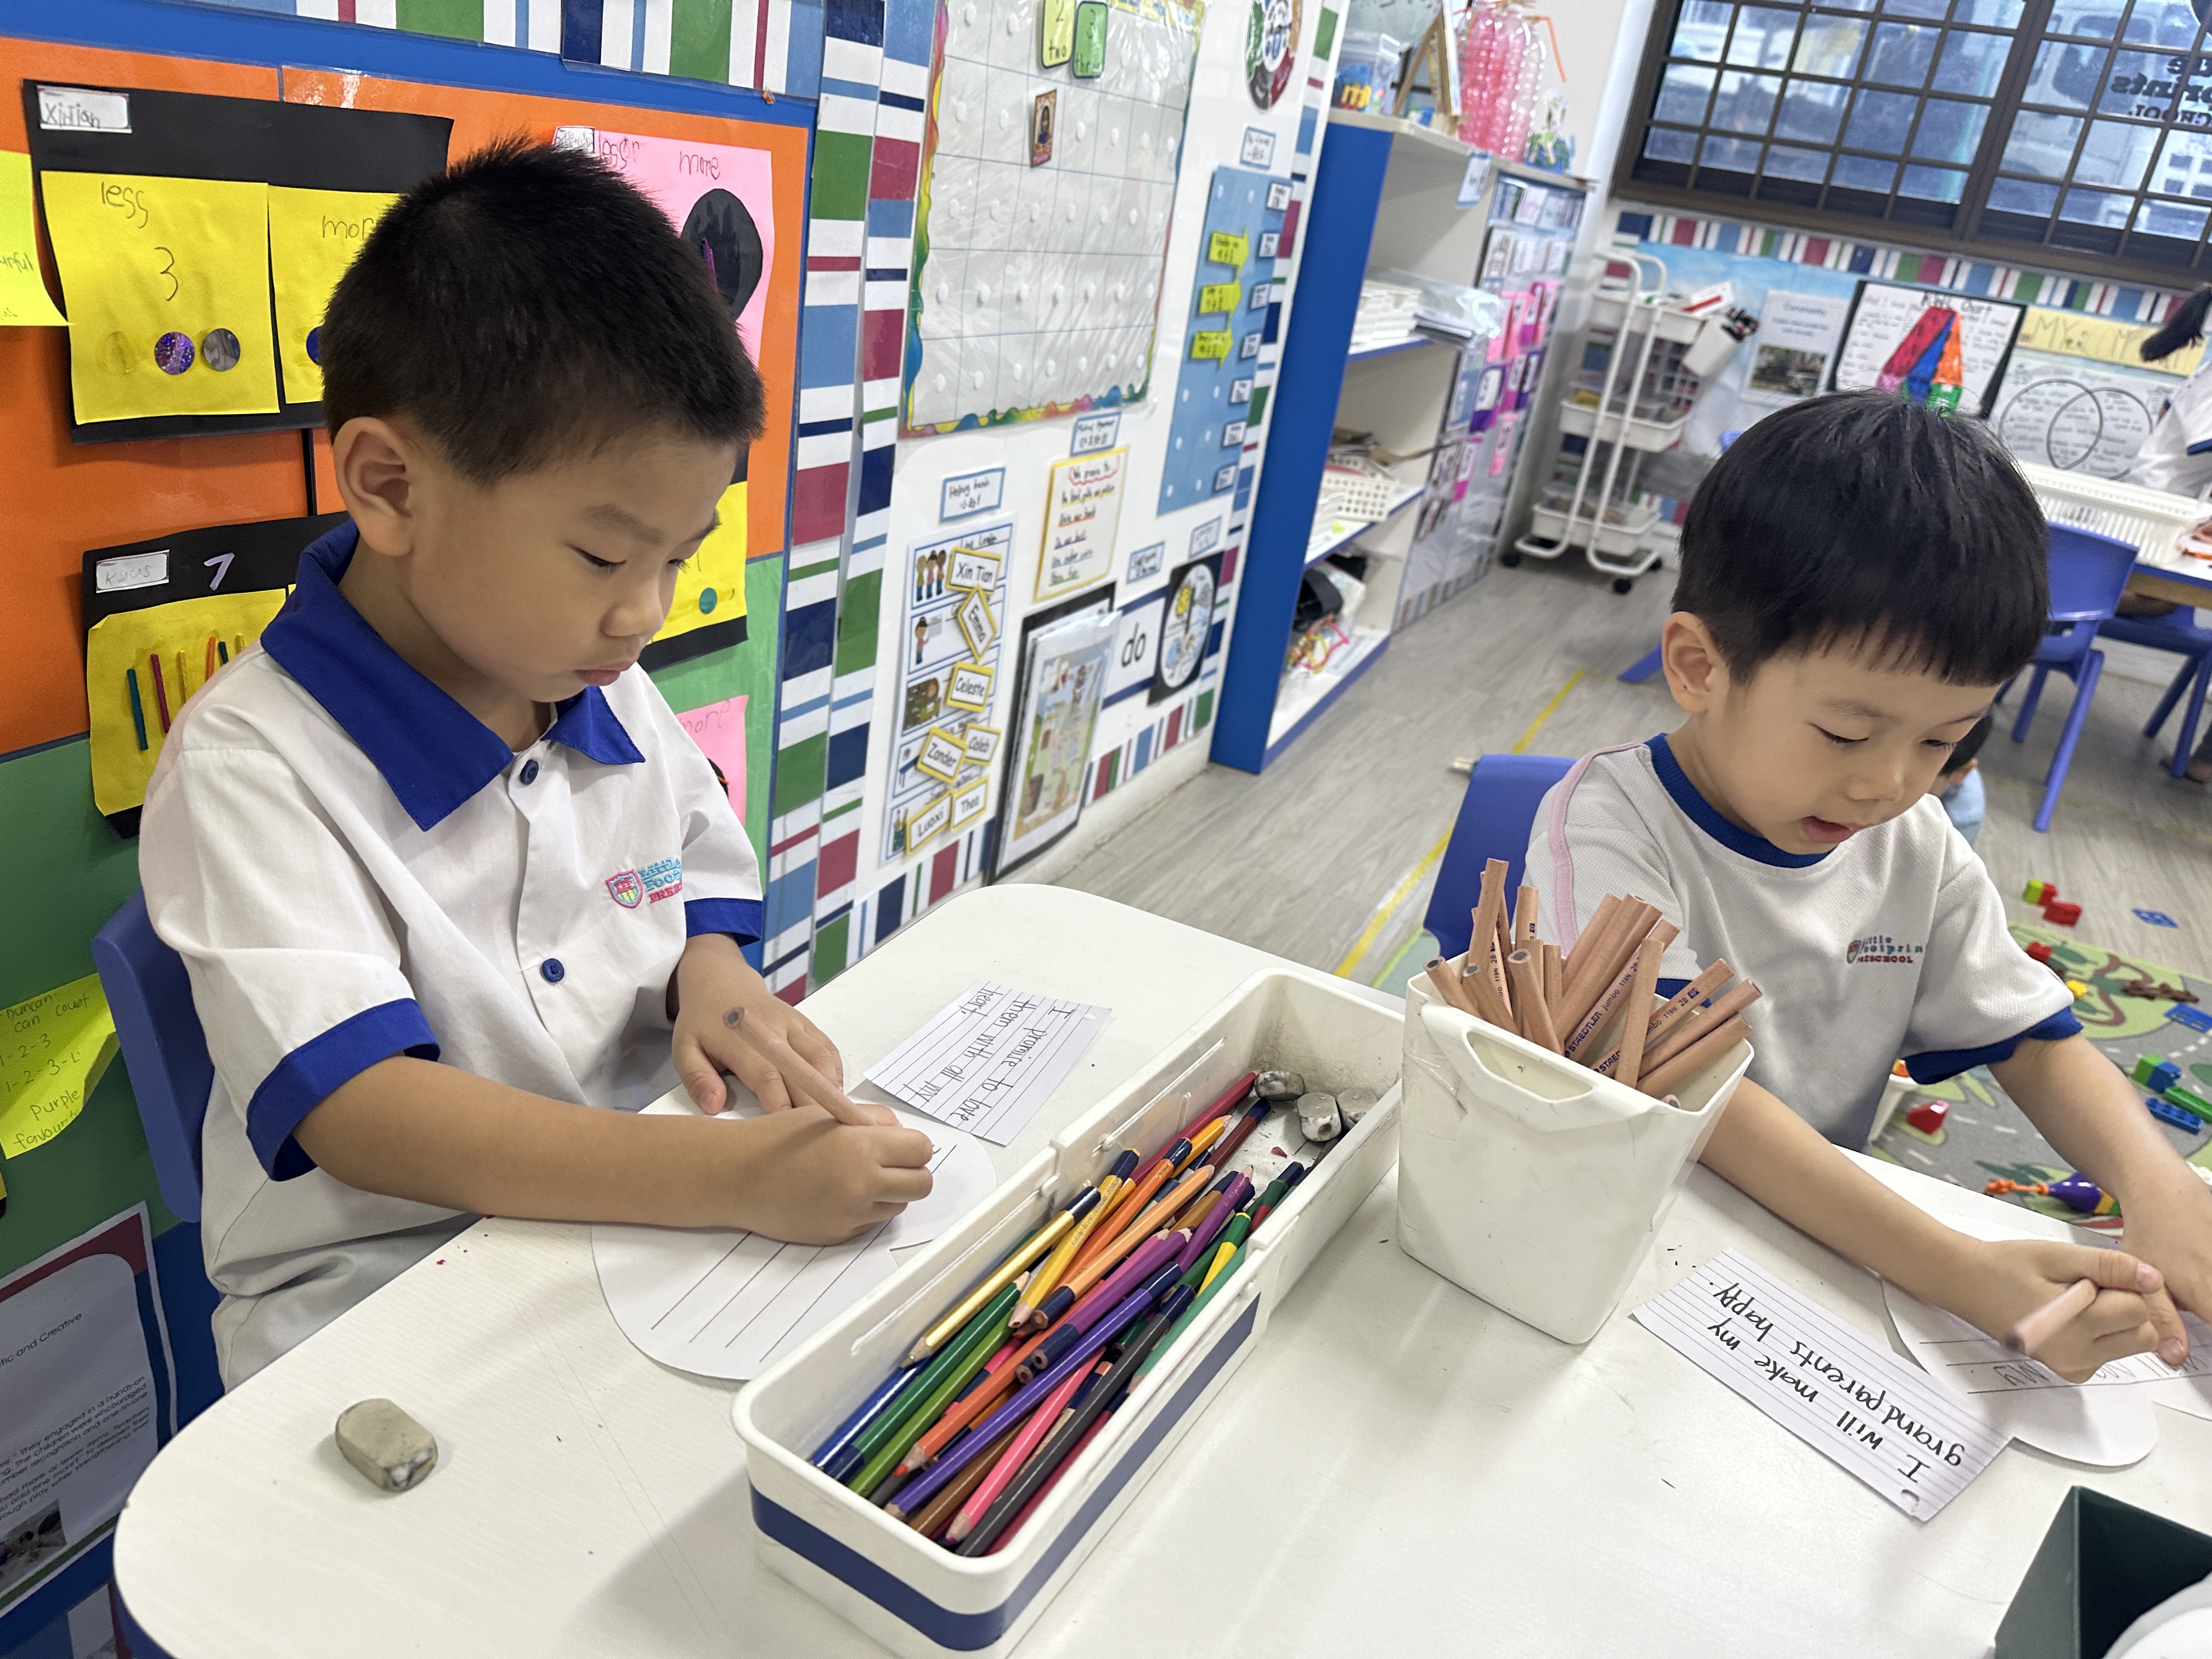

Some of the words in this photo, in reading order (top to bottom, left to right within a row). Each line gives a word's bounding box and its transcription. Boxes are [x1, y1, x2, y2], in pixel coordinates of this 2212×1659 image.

[680, 151, 720, 180] more
[101, 182, 149, 228] less
[154, 246, 179, 301] 3
[956, 561, 973, 580] Xin
[1121, 622, 1146, 667] do
[955, 677, 985, 697] Celeste
[14, 1015, 40, 1033] can
[55, 994, 90, 1017] count
[994, 998, 1037, 1028] them
[1568, 1011, 1602, 1052] STAEDTLER
[1601, 989, 1620, 1012] jumbo
[1619, 973, 1632, 987] 119N
[963, 1033, 994, 1059] with
[1001, 1027, 1047, 1067] promise
[902, 1080, 940, 1103] my
[941, 1064, 966, 1083] all
[981, 1077, 1014, 1092] to
[950, 1098, 992, 1121] love
[1709, 1282, 1775, 1342] happy.
[16, 1339, 38, 1357] and
[40, 1312, 82, 1342] Creative
[1707, 1317, 1742, 1351] my
[1754, 1353, 1819, 1403] make
[15, 1455, 32, 1467] The
[34, 1431, 70, 1457] children
[71, 1417, 93, 1434] were
[94, 1383, 146, 1419] encouraged
[20, 1439, 42, 1454] They
[44, 1412, 86, 1441] engaged
[88, 1406, 96, 1414] in
[83, 1421, 101, 1436] and
[1836, 1410, 1884, 1451] will
[1897, 1454, 1931, 1484] I
